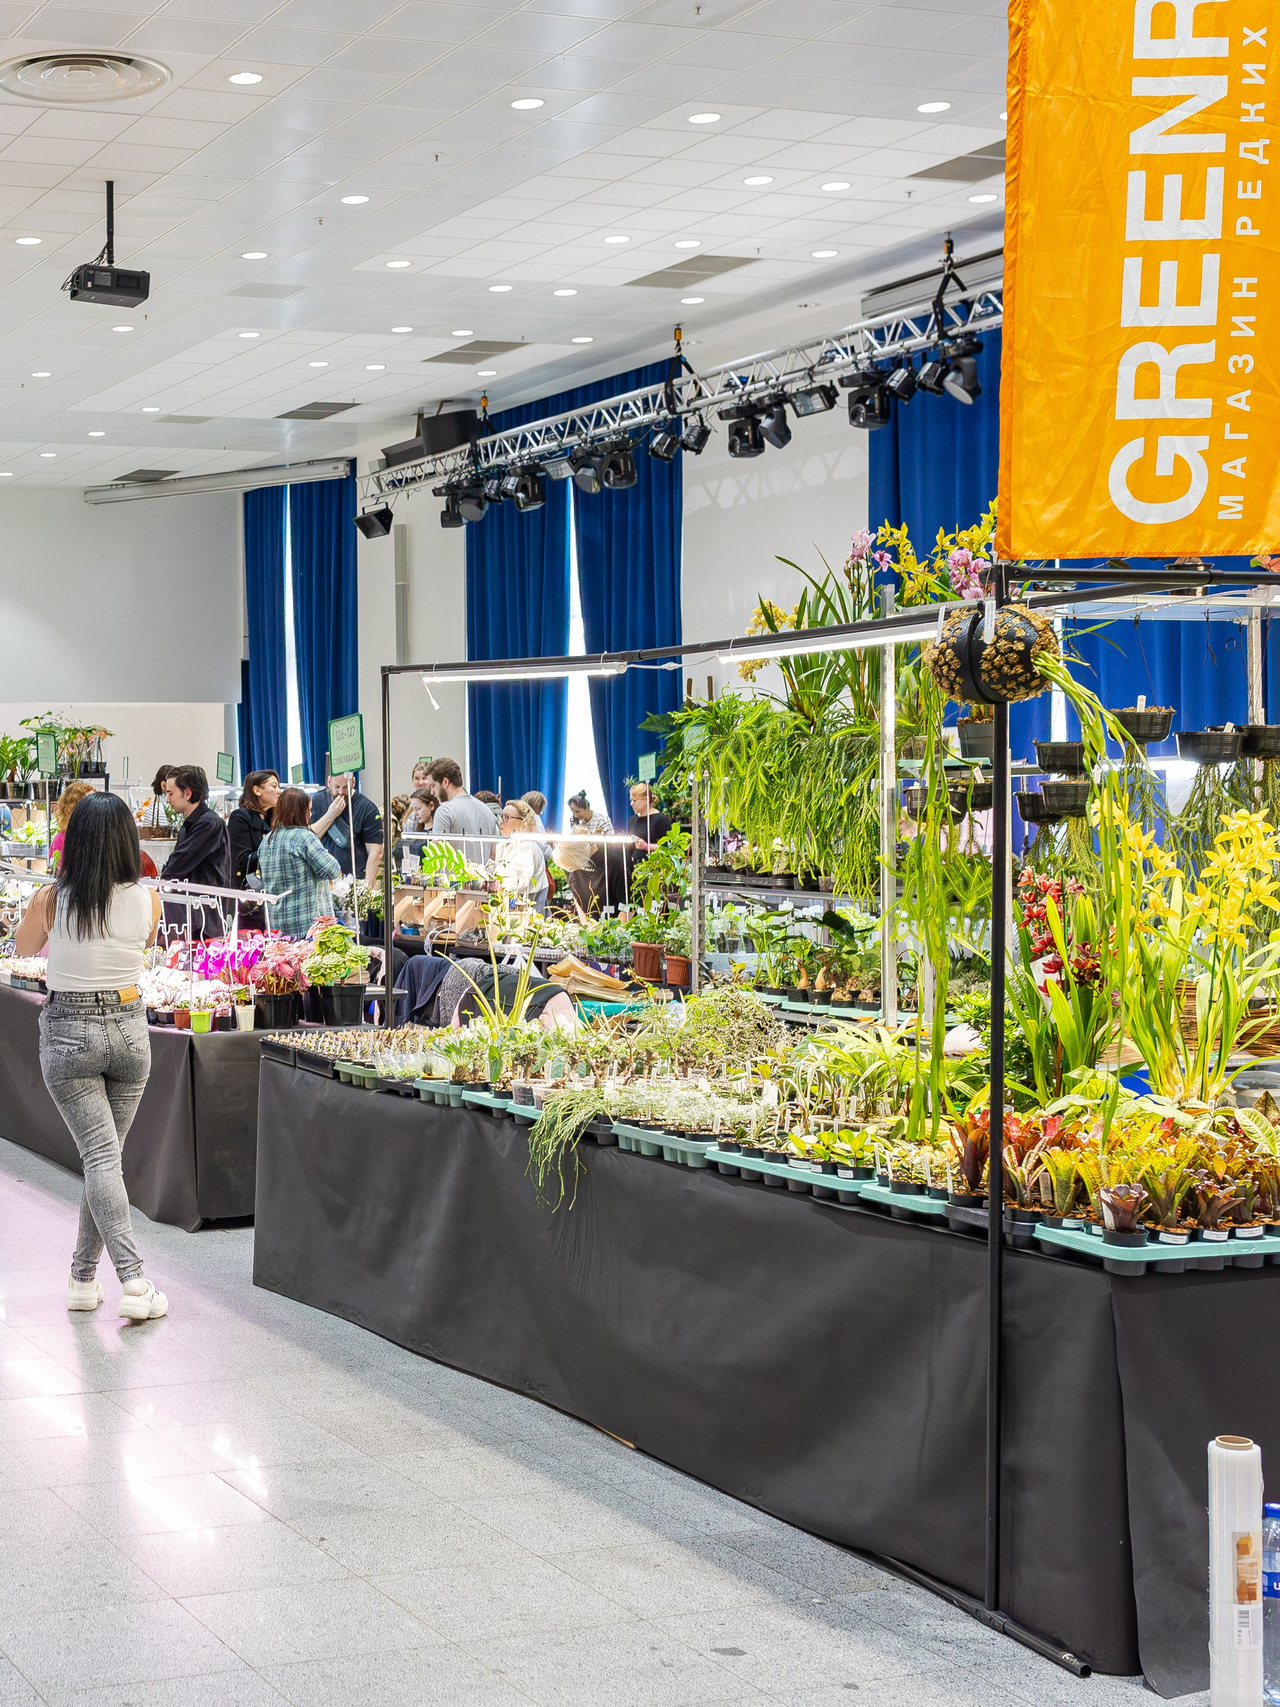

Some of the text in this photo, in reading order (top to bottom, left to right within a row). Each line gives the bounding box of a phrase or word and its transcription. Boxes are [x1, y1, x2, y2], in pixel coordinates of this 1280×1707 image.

[1108, 0, 1230, 525] GREENR
[1217, 26, 1270, 520] МАГАЗИН РЕДКИХ
[335, 725, 356, 741] 126-127
